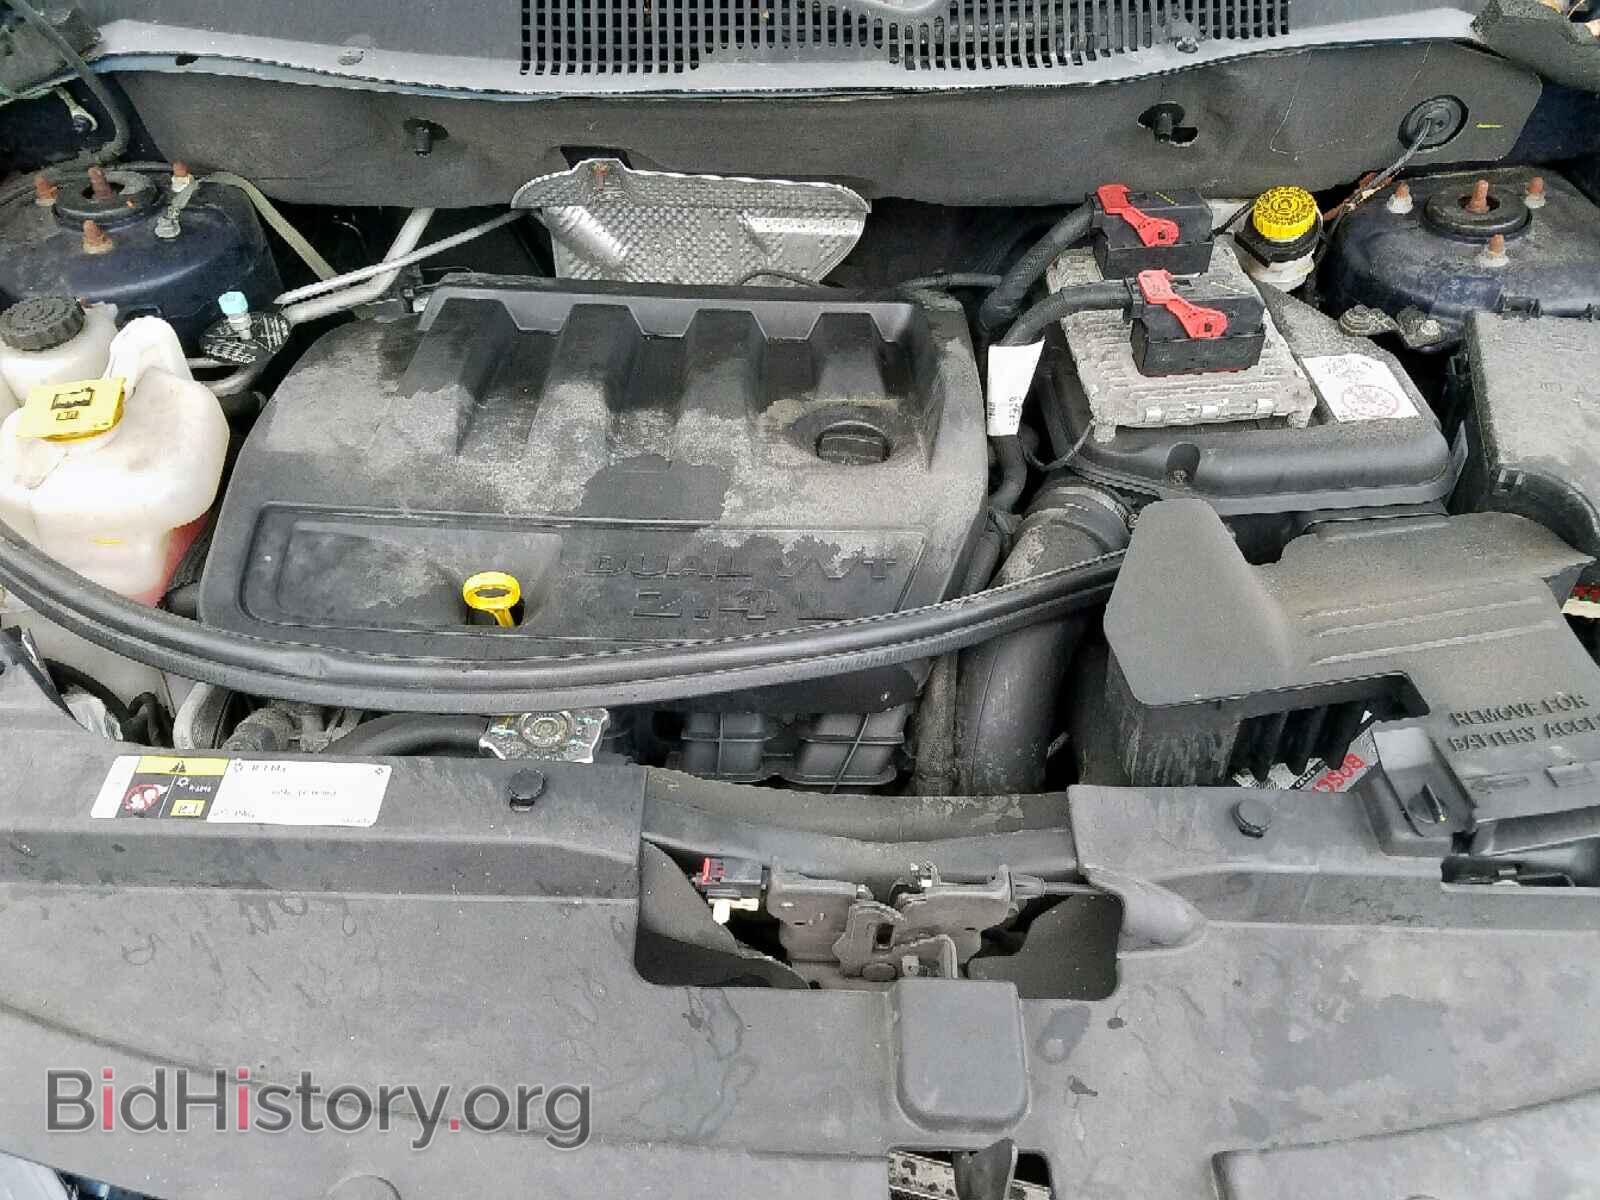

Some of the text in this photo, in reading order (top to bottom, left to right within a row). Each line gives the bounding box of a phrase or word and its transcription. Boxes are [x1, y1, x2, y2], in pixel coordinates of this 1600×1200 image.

[584, 554, 898, 581] DUAL VVT
[1449, 693, 1590, 728] REMOVE FOR
[1448, 726, 1537, 752] BATTERY
